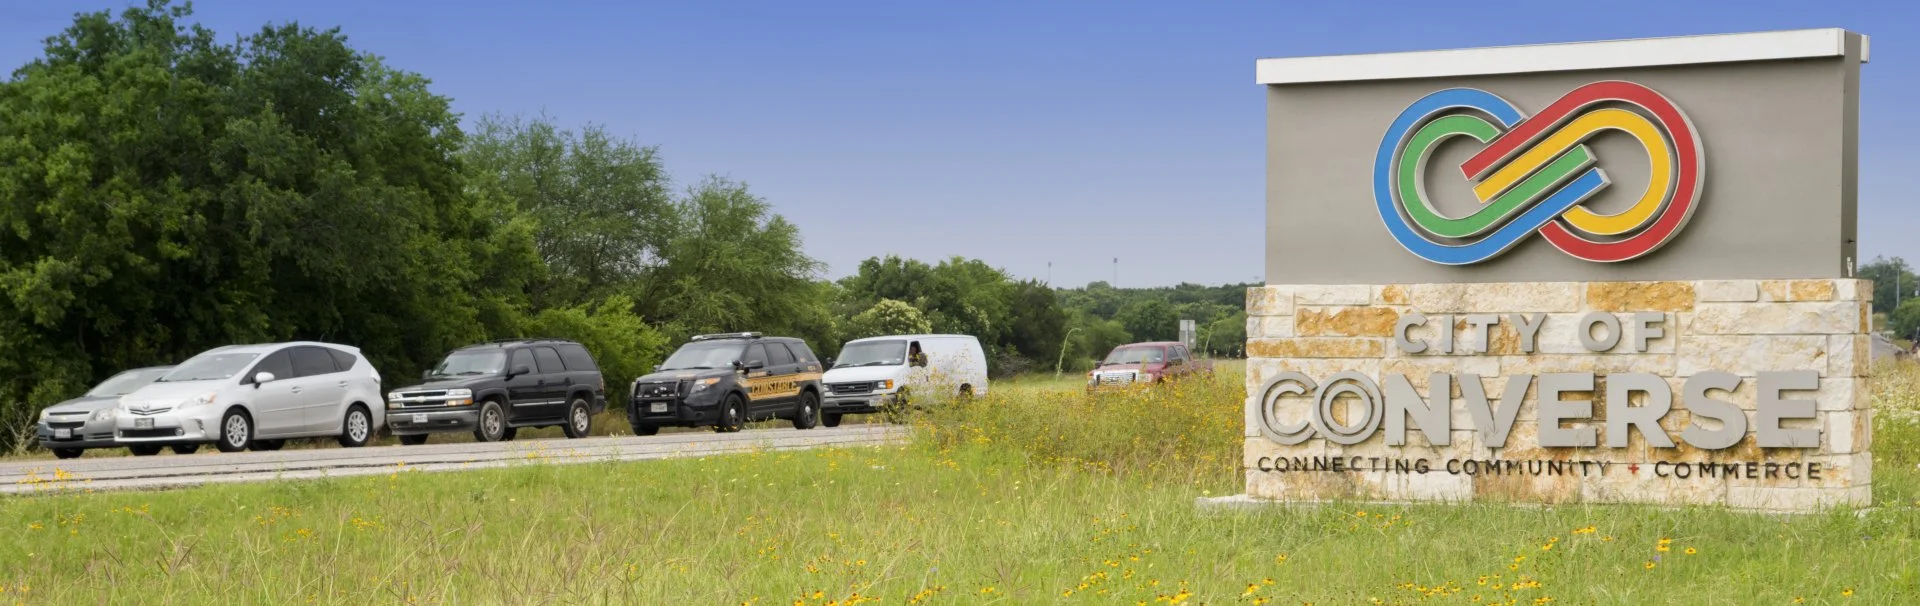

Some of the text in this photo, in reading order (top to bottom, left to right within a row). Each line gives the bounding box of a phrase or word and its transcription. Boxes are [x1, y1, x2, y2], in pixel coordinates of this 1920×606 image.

[1398, 312, 1665, 353] CITY OF
[1256, 371, 1821, 450] CONVERSE
[1258, 456, 1430, 475] CONNECTING
[1446, 458, 1611, 477] COMMUNITY
[1655, 461, 1822, 480] COMMERCE
